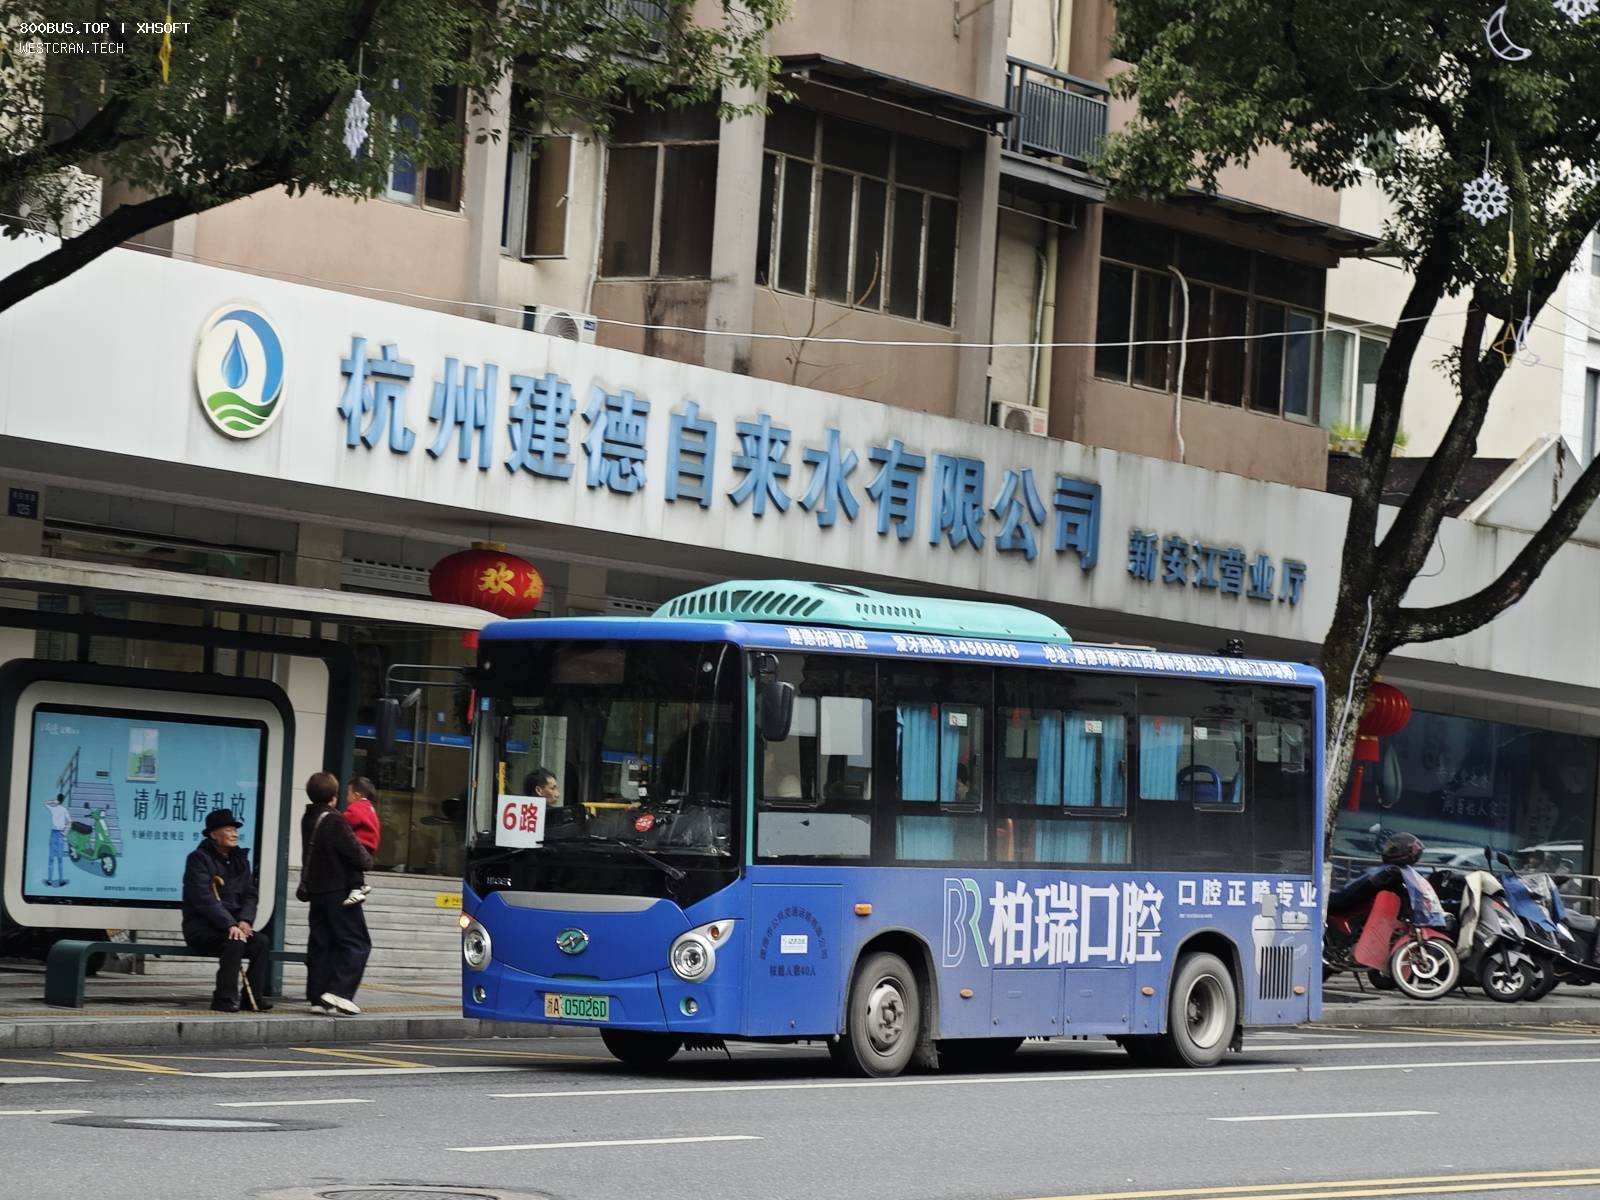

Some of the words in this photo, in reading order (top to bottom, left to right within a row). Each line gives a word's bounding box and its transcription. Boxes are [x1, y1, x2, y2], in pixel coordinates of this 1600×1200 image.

[337, 335, 1102, 572] 杭州建德自来水有限公司
[1127, 527, 1307, 606] 新安江营业厅
[502, 802, 539, 833] 6路
[988, 879, 1165, 966] 柏瑞口腔
